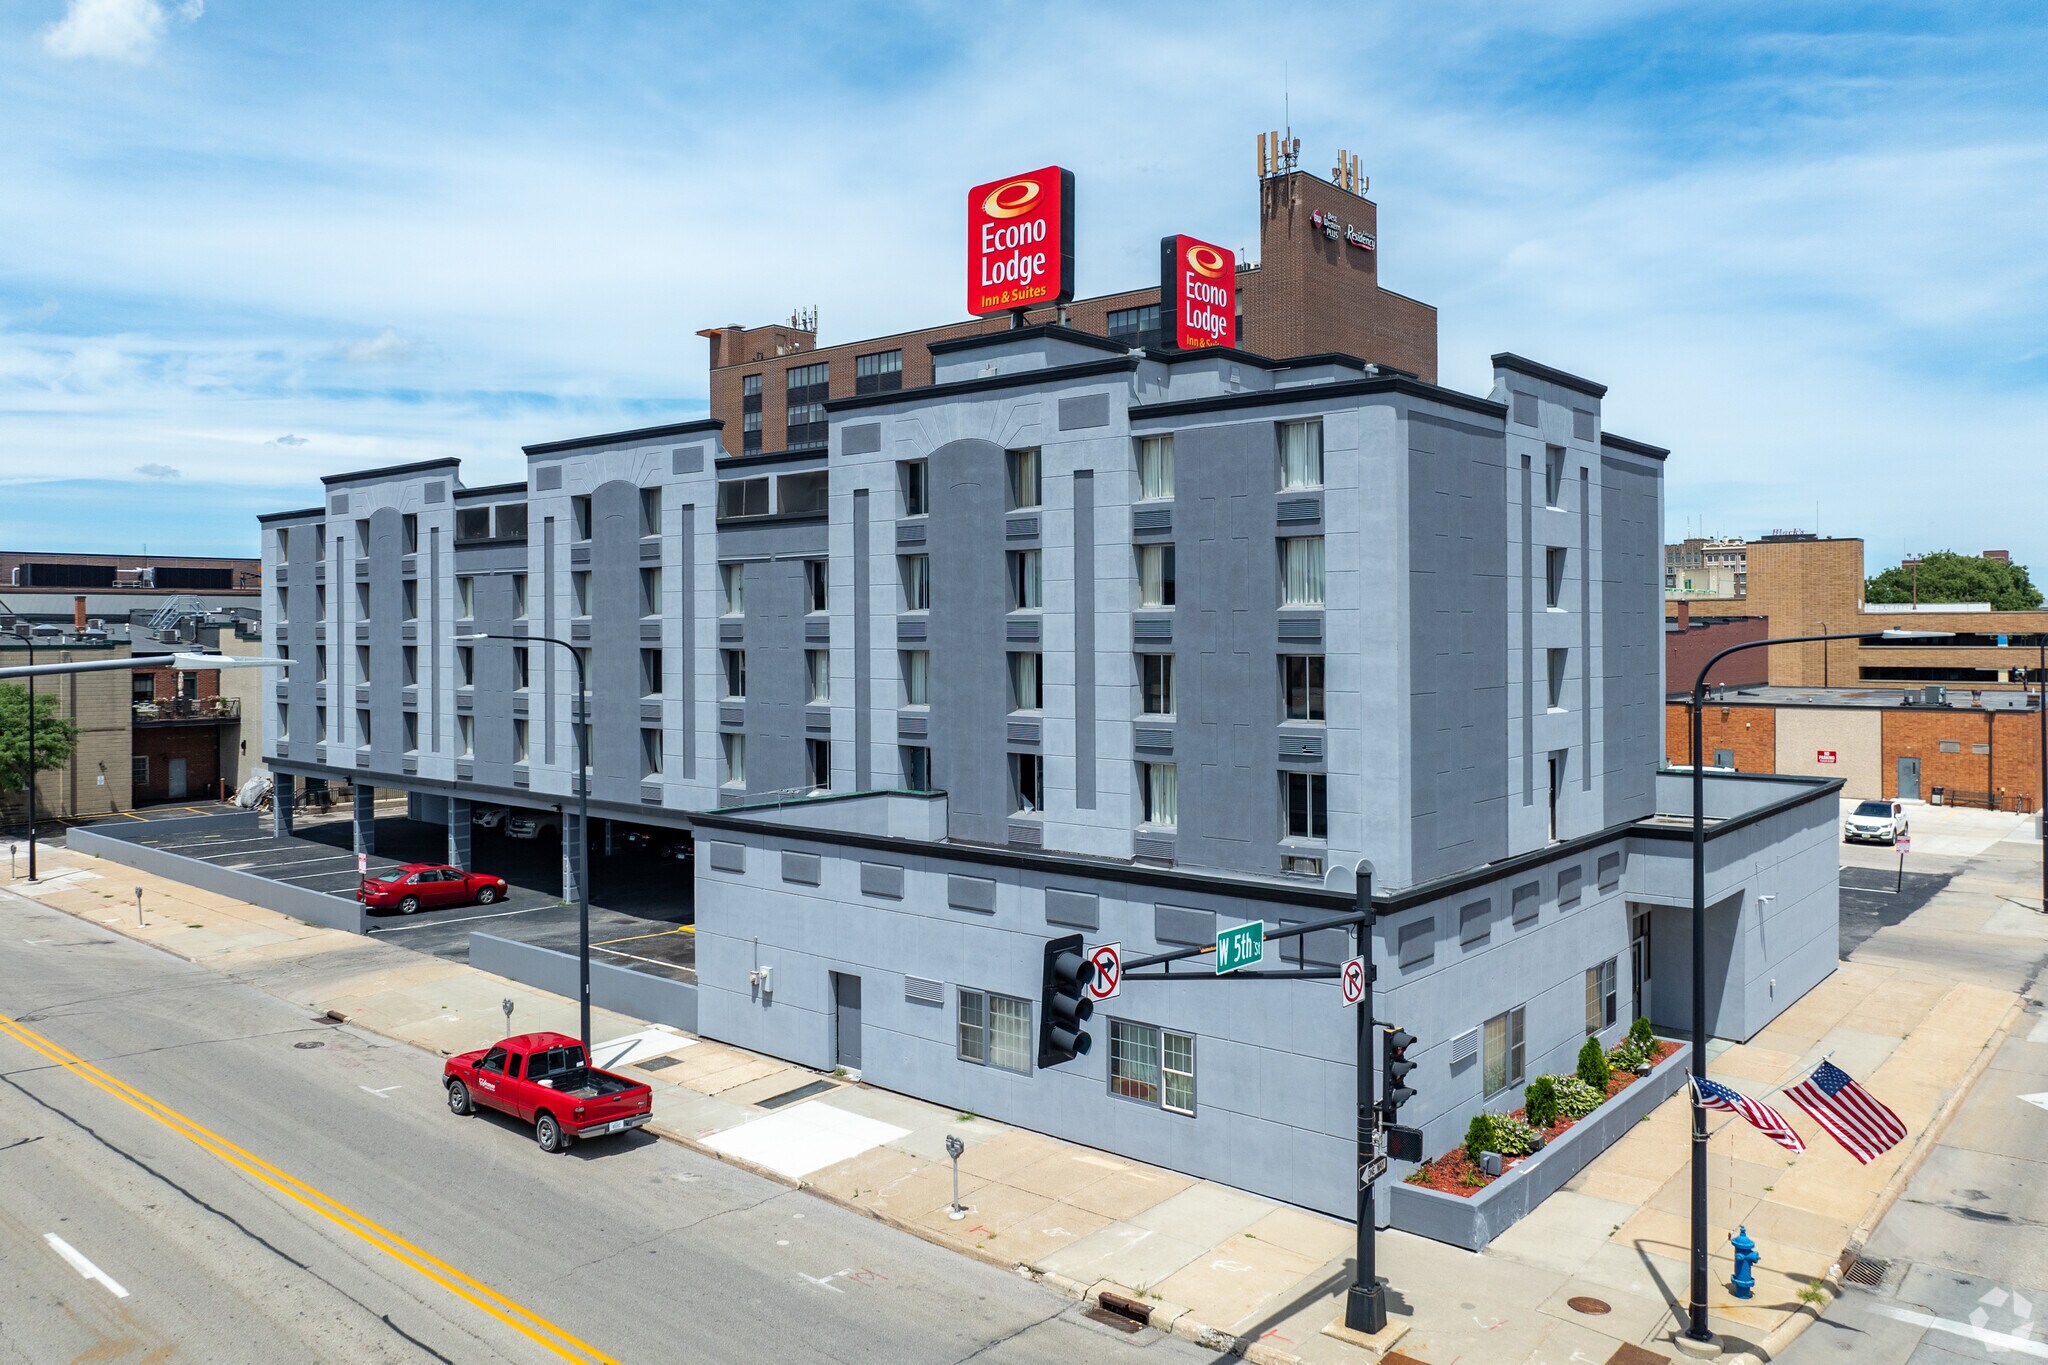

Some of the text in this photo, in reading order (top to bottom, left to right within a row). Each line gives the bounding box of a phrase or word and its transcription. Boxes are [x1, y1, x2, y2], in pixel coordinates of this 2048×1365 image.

[982, 218, 1047, 254] Econo
[1326, 228, 1338, 239] PLUS
[1346, 224, 1375, 250] Residency
[982, 249, 1046, 287] Lodge
[981, 286, 1047, 307] Inn & Suites
[1186, 271, 1227, 308] Econo
[1186, 300, 1227, 339] Lodge
[1186, 334, 1199, 346] Inn
[1219, 937, 1229, 967] W
[1234, 931, 1252, 962] 5th
[1368, 1159, 1385, 1177] ONE WAY
